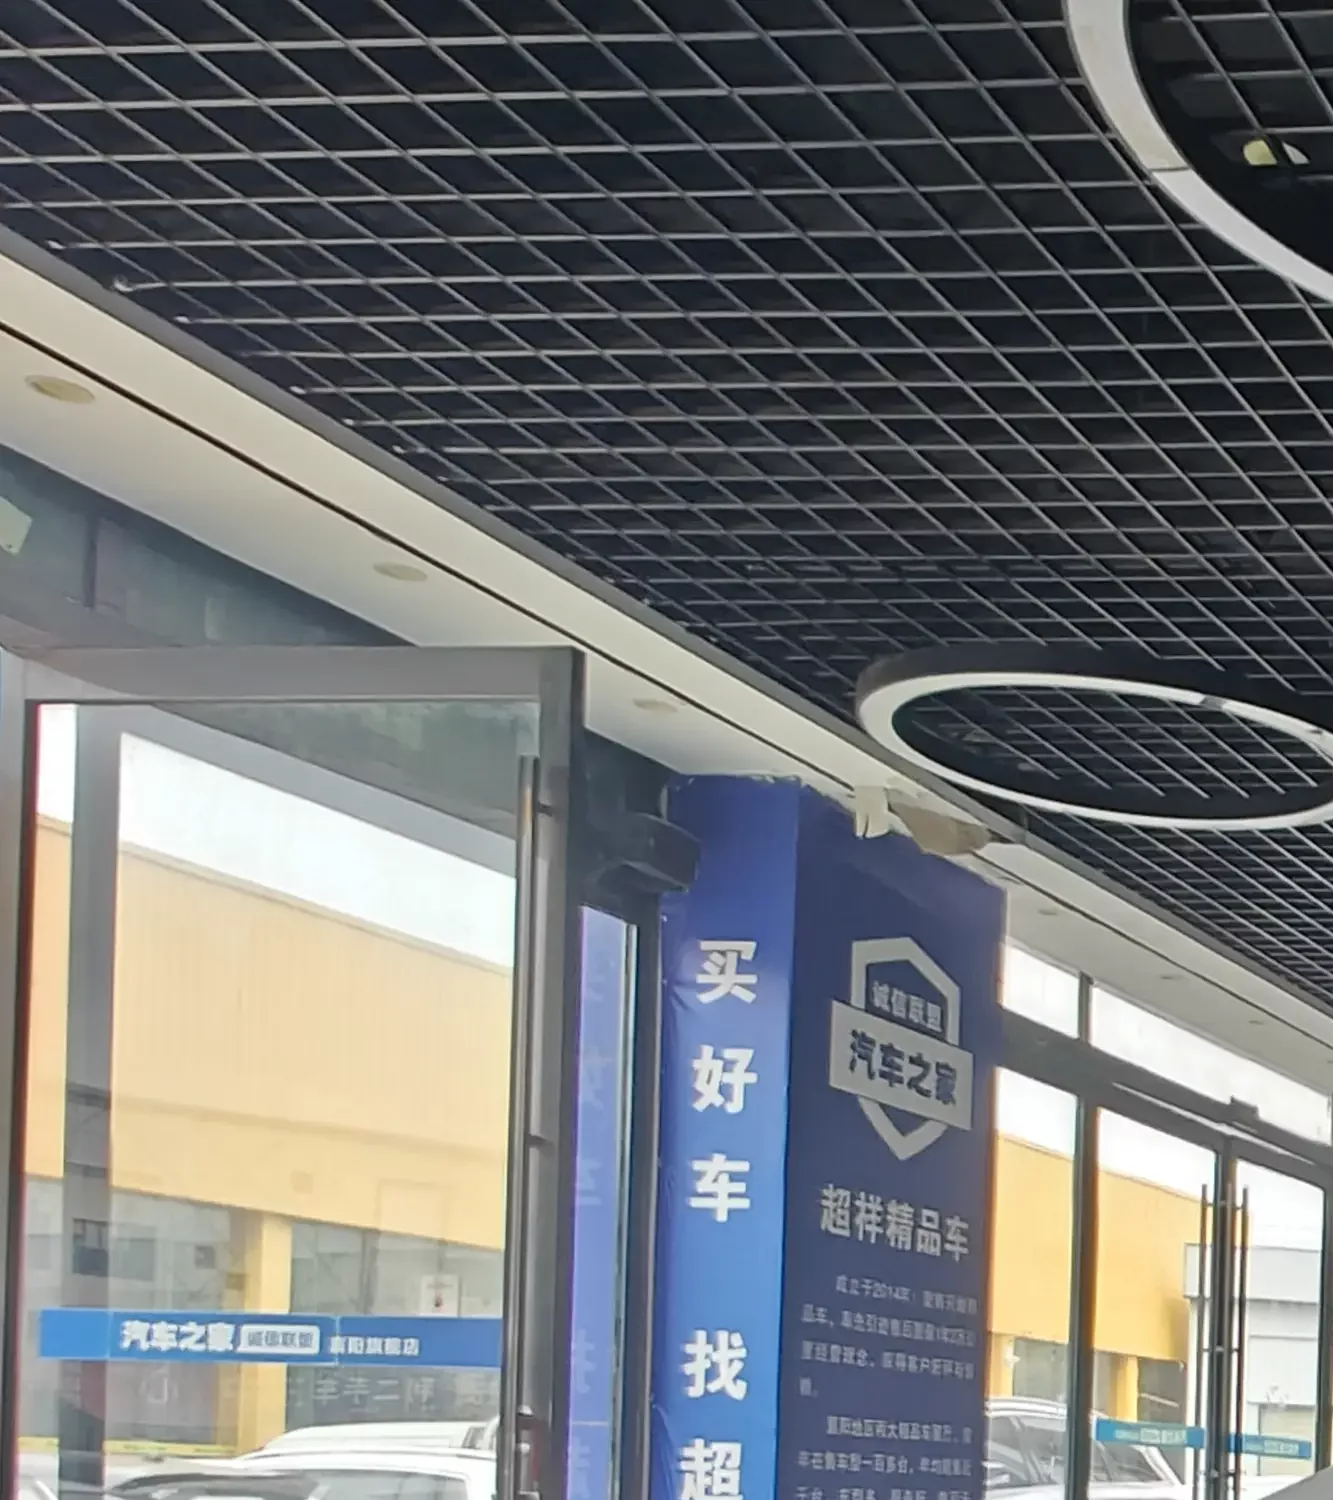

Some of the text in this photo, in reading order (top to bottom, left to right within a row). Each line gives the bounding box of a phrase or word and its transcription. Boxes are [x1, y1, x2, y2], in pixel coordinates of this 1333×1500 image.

[872, 980, 942, 1033] 诚信联盟
[688, 939, 758, 1223] 买好车
[848, 1028, 957, 1106] 汽车之家
[819, 1184, 970, 1263] 超祥精品车
[119, 1320, 235, 1352] 汽车之家
